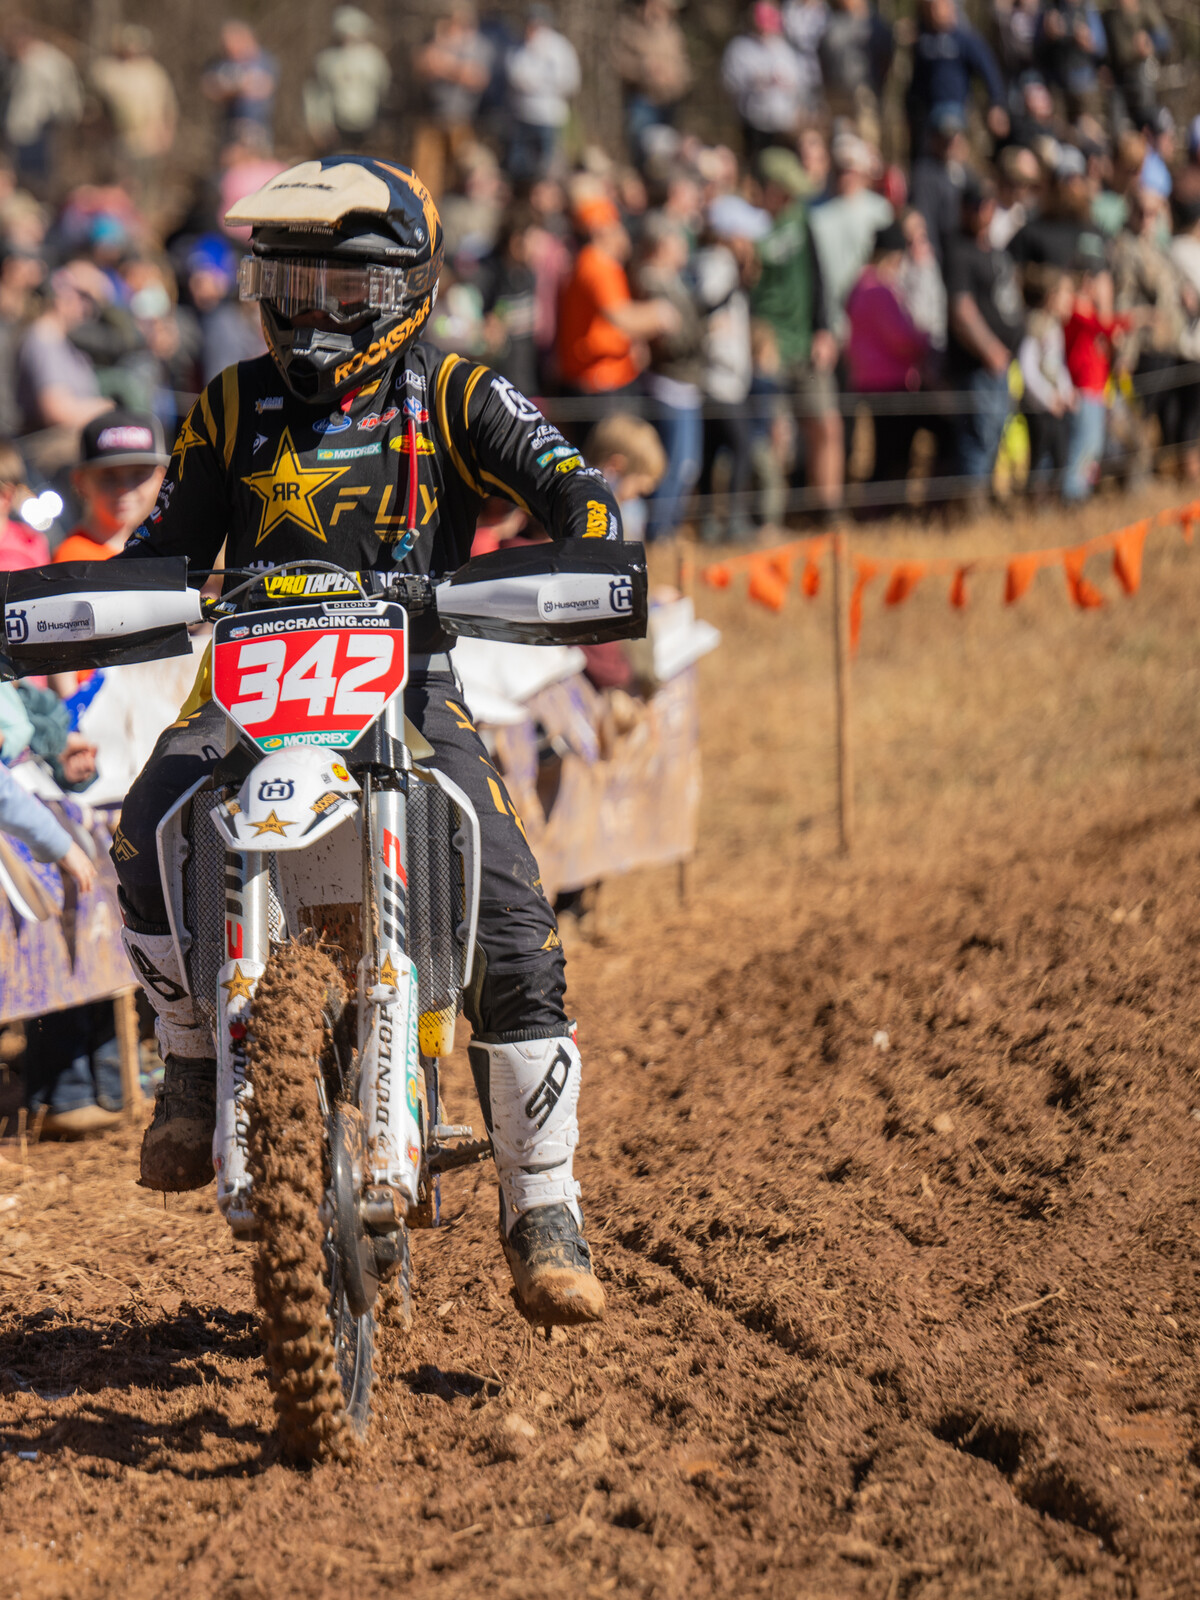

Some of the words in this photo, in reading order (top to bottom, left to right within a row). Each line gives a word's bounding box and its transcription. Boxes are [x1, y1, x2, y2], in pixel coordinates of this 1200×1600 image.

[334, 297, 431, 386] ROCKSTAR
[334, 443, 380, 460] MOTOREX
[329, 484, 439, 526] FLY
[333, 601, 371, 609] DELONG
[554, 599, 599, 610] Husqvarna
[47, 618, 90, 631] Husqvarna
[230, 633, 395, 726] 342
[283, 733, 349, 748] MOTOREX
[376, 1002, 393, 1127] DUNLOP
